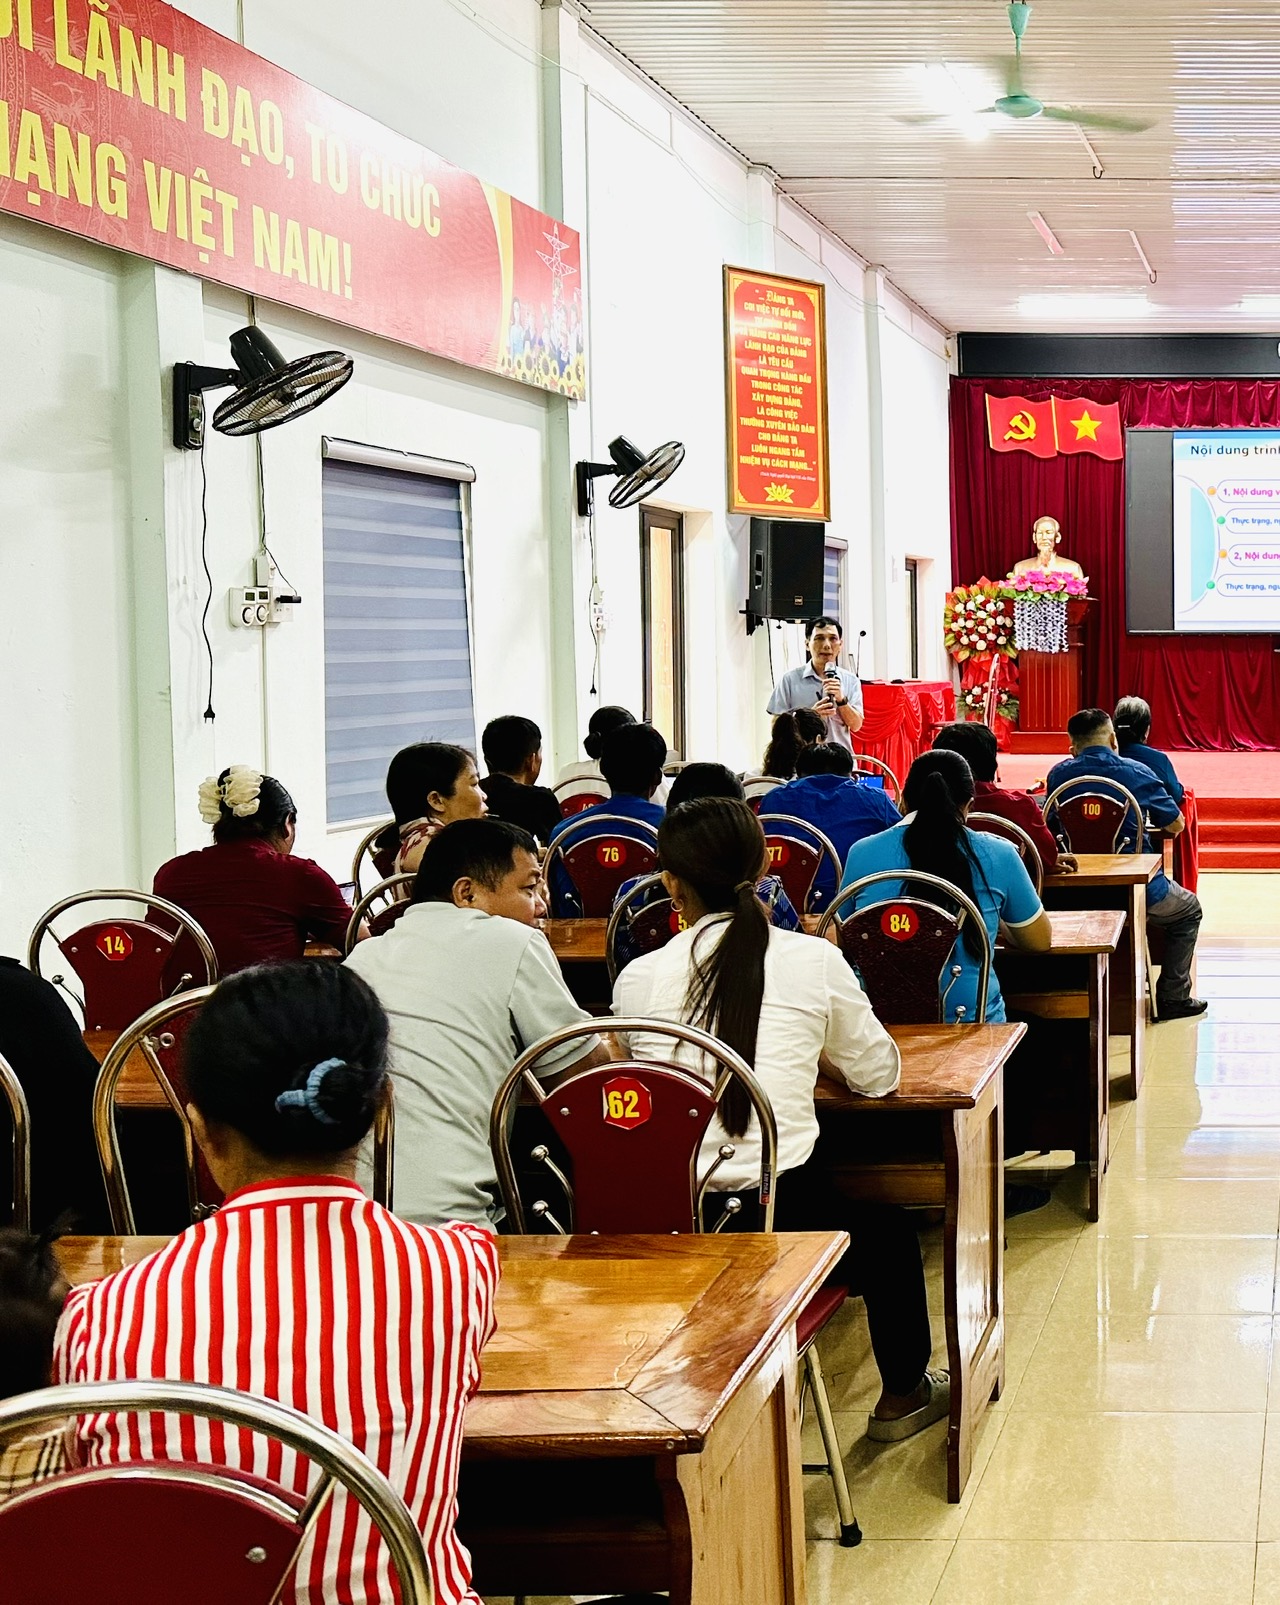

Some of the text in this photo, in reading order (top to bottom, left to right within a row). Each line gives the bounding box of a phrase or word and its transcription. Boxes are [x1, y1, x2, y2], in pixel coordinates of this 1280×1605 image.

[54, 0, 187, 123] LÃNH
[201, 66, 294, 179] ĐẠO,
[0, 100, 353, 300] ẠNG VIỆT NAM!
[1190, 445, 1212, 457] Nội
[1217, 445, 1248, 457] dung
[1233, 488, 1248, 498] Nội
[1250, 488, 1273, 497] dung
[1232, 517, 1250, 526] Thực
[1252, 517, 1272, 526] trạng,
[1244, 552, 1260, 562] Nội
[1226, 583, 1244, 592] Thực
[1083, 803, 1101, 816] 100
[602, 846, 619, 862] 76
[890, 913, 911, 933] 84
[103, 935, 125, 955] 14
[607, 1089, 640, 1119] 62
